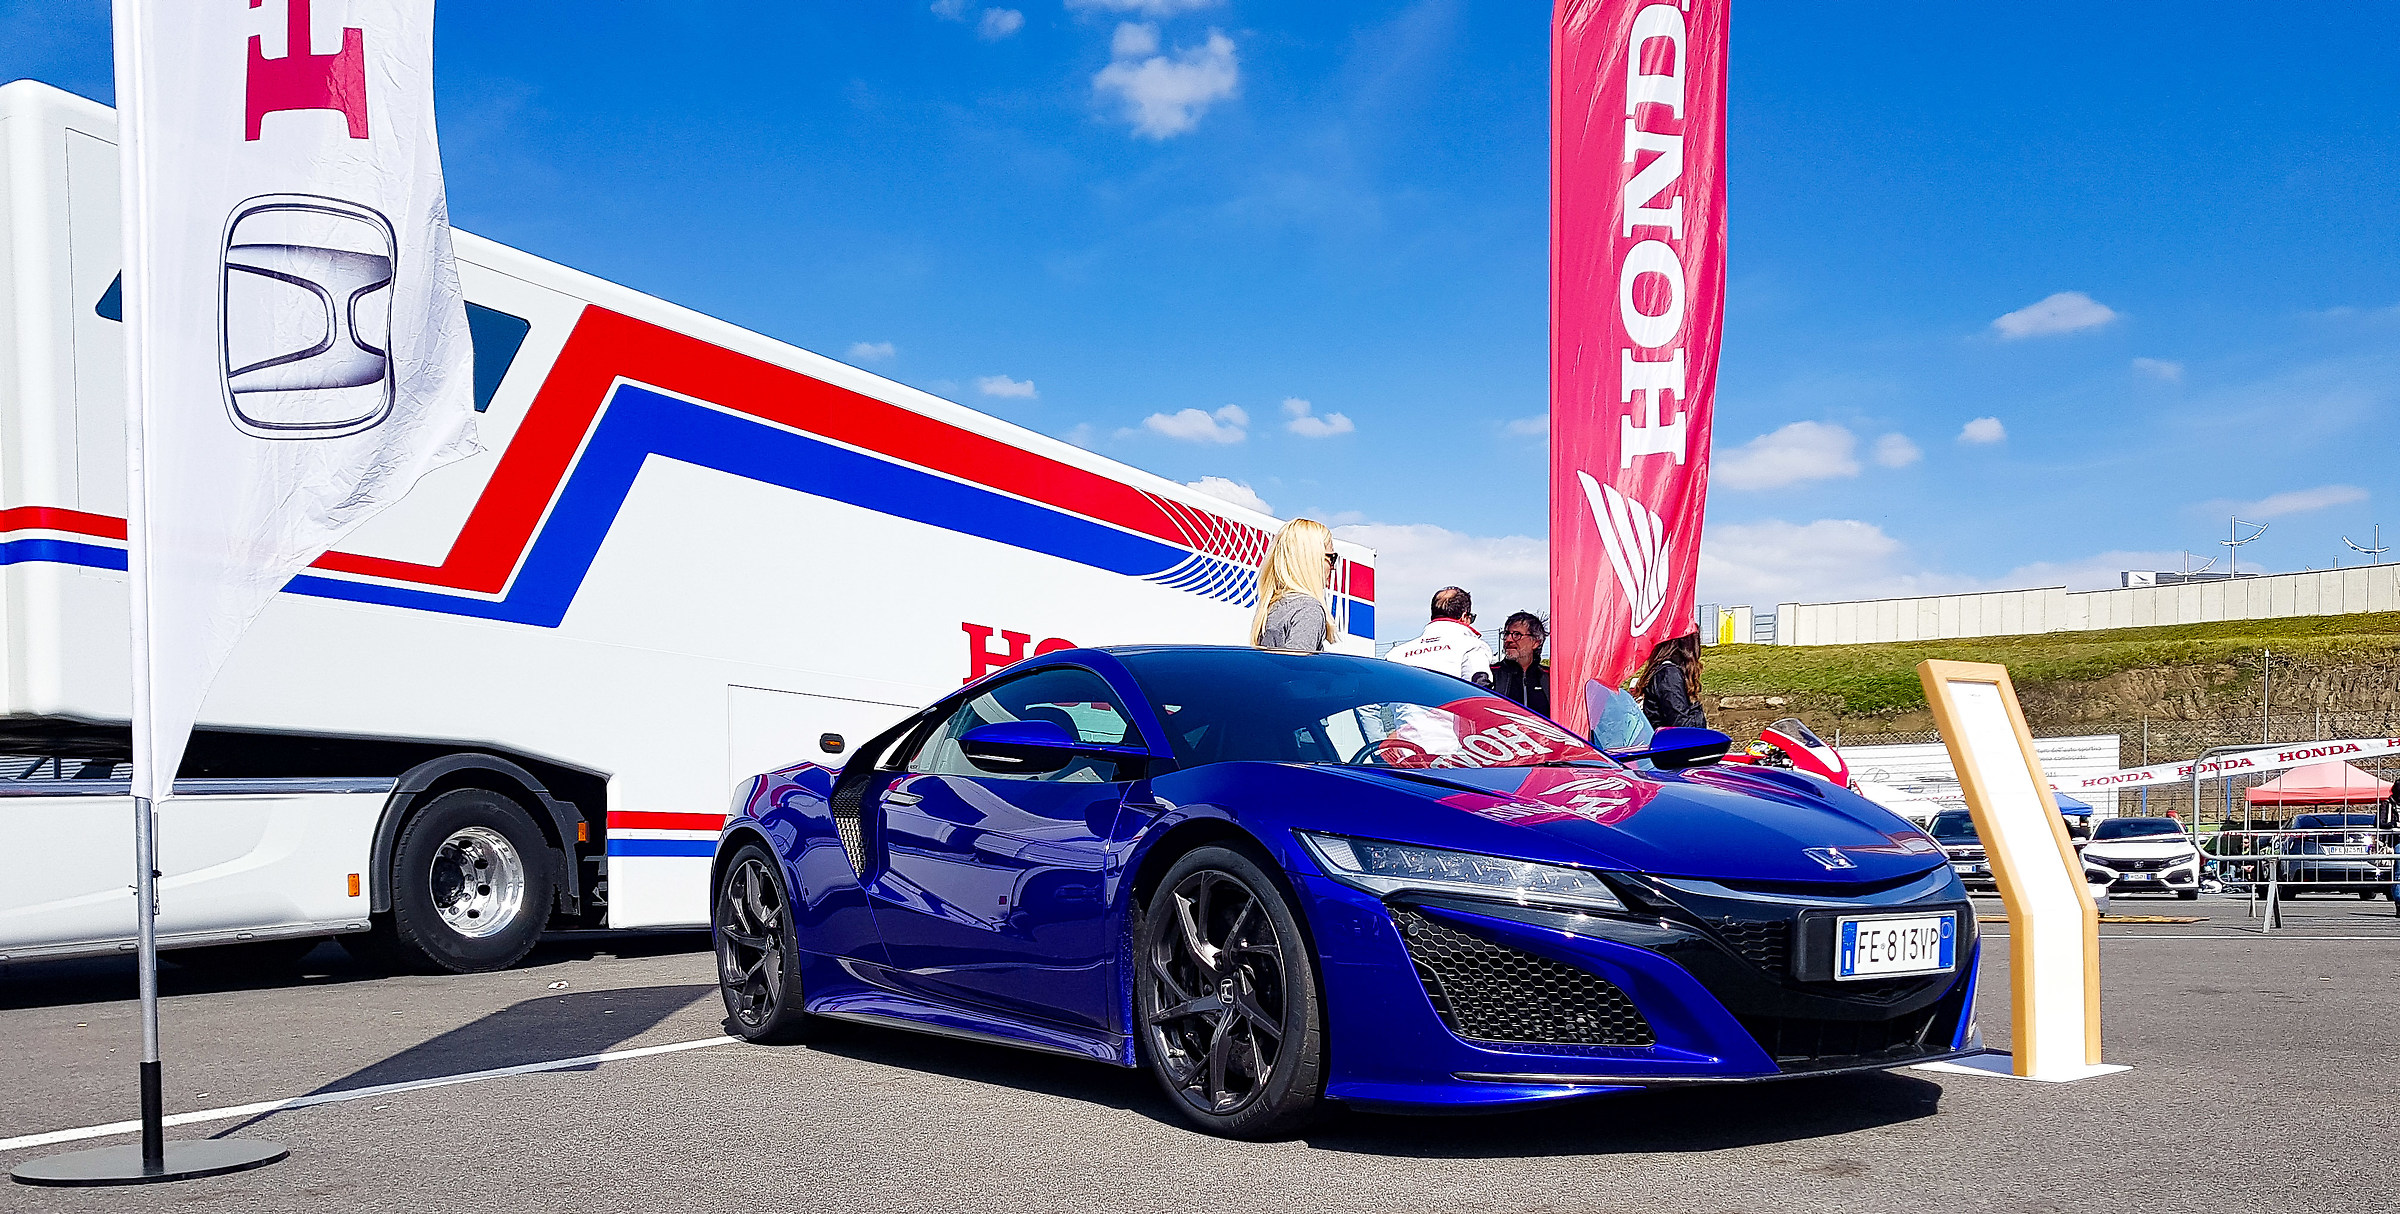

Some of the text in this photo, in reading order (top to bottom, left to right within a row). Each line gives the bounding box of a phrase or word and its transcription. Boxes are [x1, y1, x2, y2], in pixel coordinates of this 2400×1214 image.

[1620, 0, 1690, 470] HOND
[962, 622, 1079, 685] H
[1404, 645, 1451, 658] HONDA
[2081, 771, 2155, 788] HONDA
[2177, 757, 2255, 776] HONDA
[2278, 743, 2362, 762] HONDA
[1857, 931, 1881, 965] FE
[1887, 927, 1939, 962] 813VP
